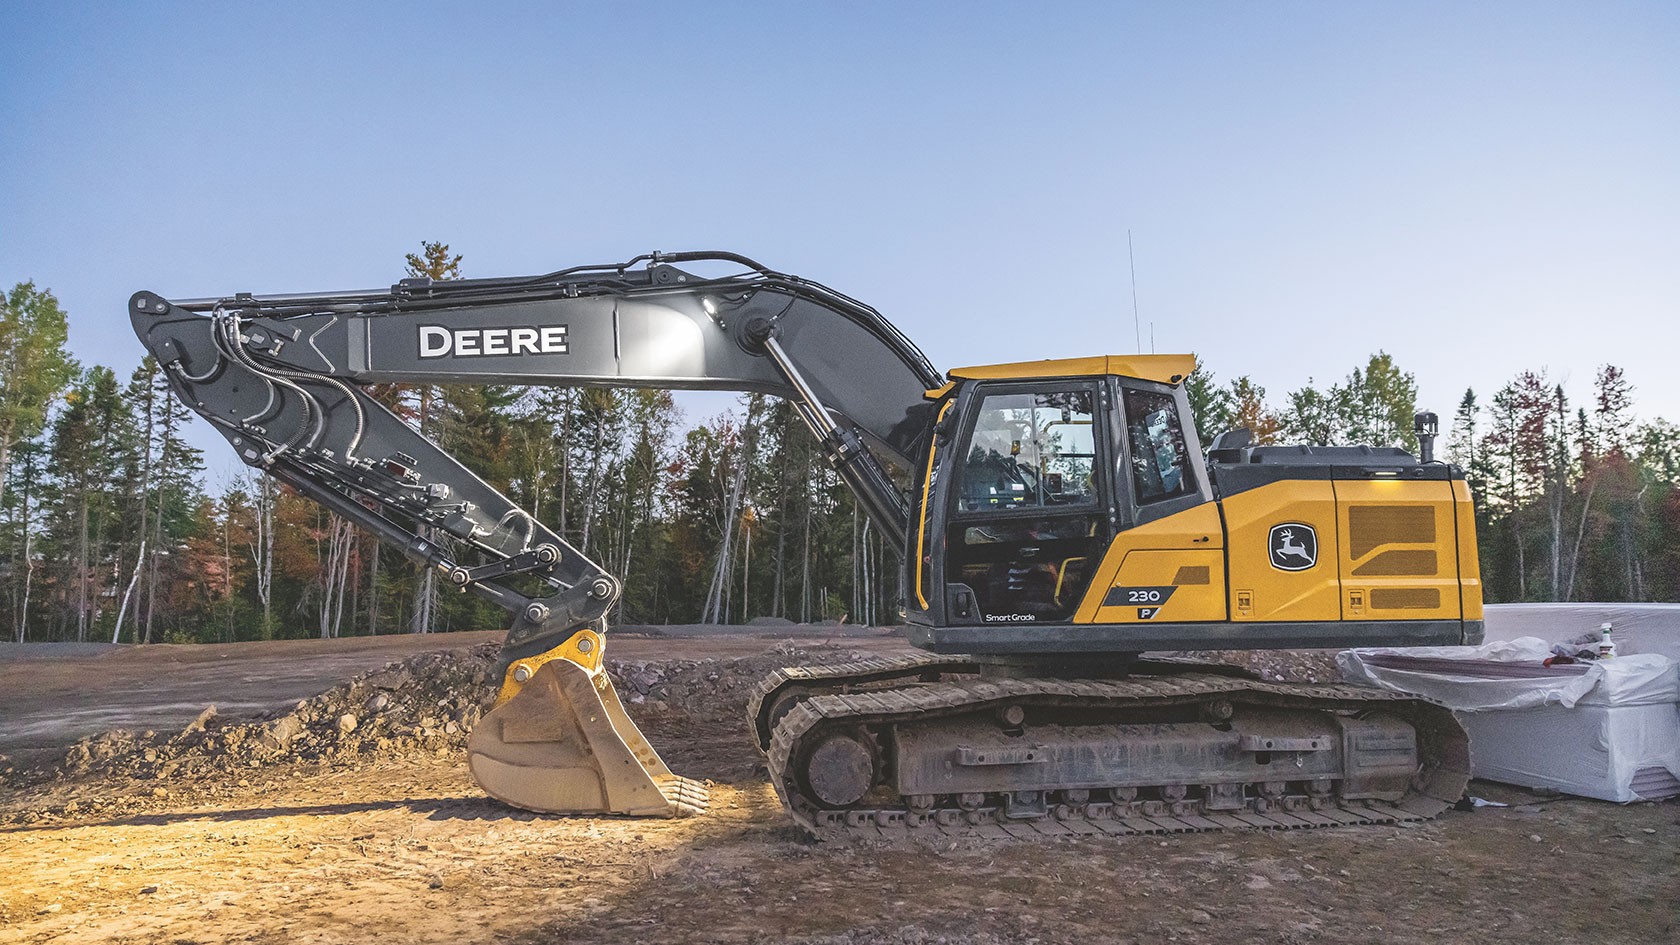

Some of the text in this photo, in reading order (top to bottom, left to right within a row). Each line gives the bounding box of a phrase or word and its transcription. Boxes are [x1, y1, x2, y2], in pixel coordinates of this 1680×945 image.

[419, 326, 567, 357] DEERE
[1128, 590, 1160, 602] 230
[986, 613, 1036, 622] Smart Grade
[1141, 609, 1151, 619] P
